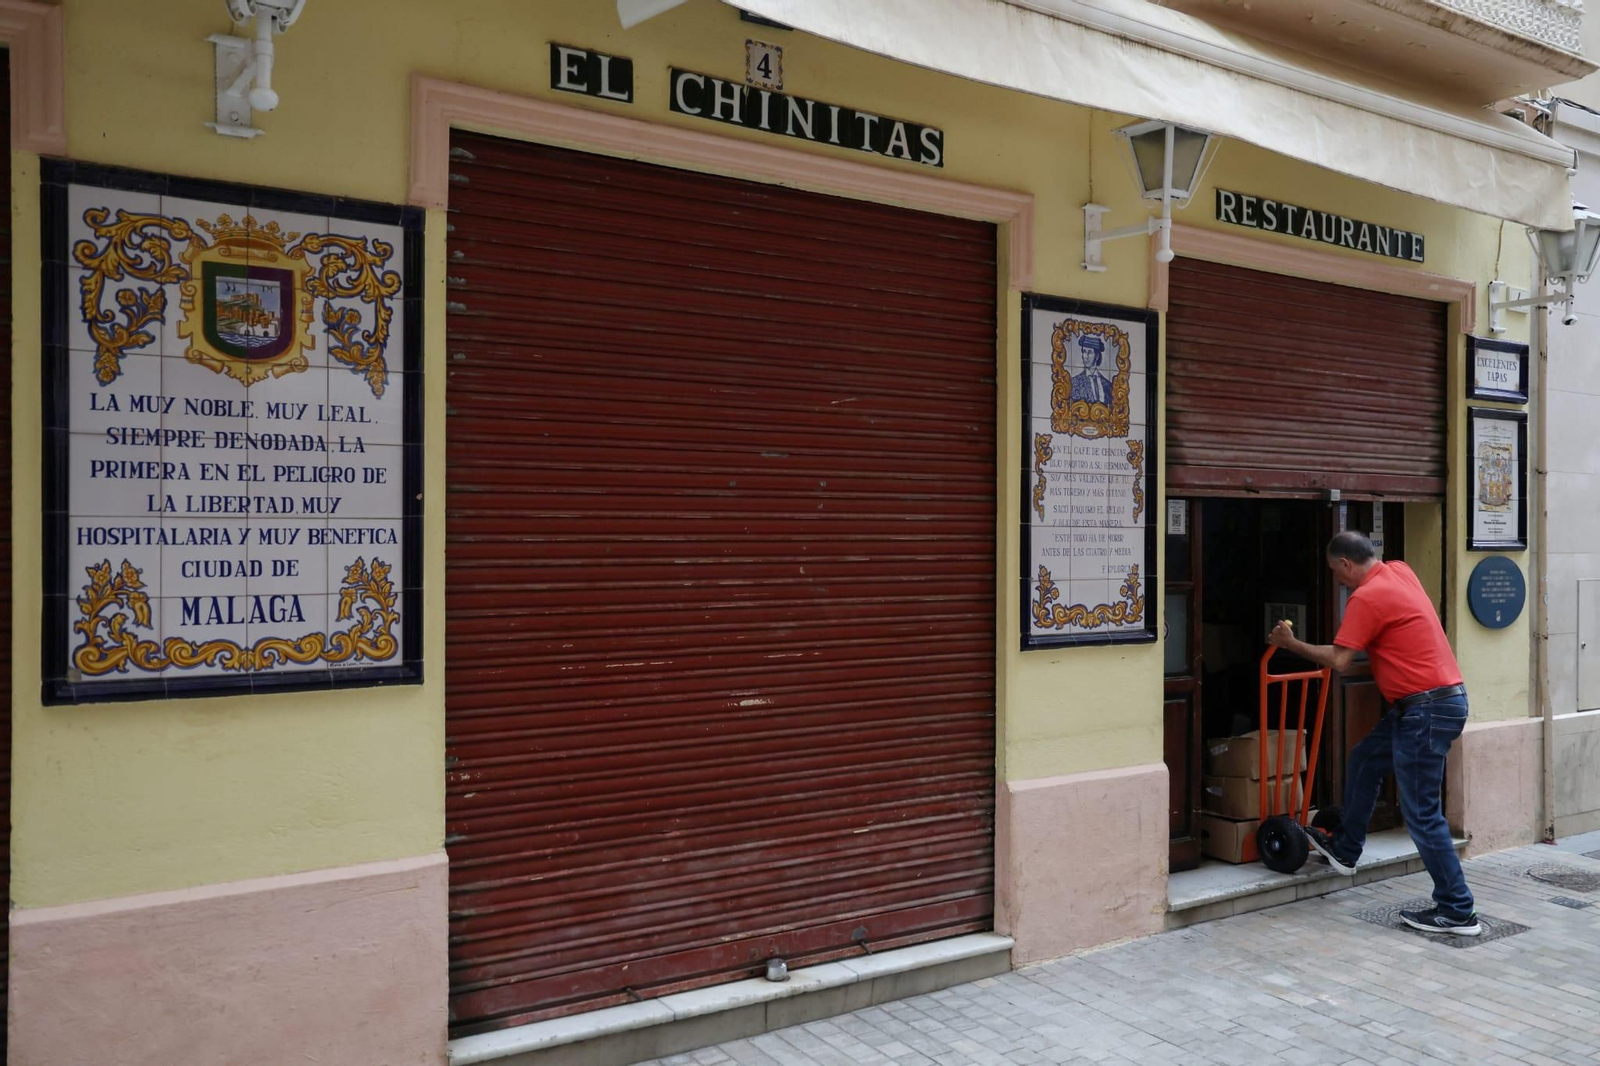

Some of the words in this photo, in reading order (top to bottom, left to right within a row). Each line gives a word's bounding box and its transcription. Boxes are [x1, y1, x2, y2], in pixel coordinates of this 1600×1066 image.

[757, 52, 773, 80] 4
[556, 46, 629, 101] EL
[675, 71, 942, 166] CHINITAS
[1218, 189, 1424, 262] RESTAURANTE
[1476, 356, 1517, 371] EXCELENTES
[1487, 371, 1507, 383] TAPAS
[89, 393, 121, 412] LA
[129, 394, 176, 413] MUY
[266, 402, 309, 421] MUY
[106, 427, 205, 448] SIEMPRE
[339, 435, 366, 453] LA
[1092, 447, 1099, 456] DE
[90, 460, 191, 480] PRIMERA
[200, 463, 230, 482] EN
[237, 464, 266, 482] EL
[273, 465, 356, 484] PELIGRO
[363, 467, 387, 484] DE
[147, 494, 177, 513] LA
[301, 497, 342, 514] MUY
[77, 527, 233, 546] HOSPITALARIA
[238, 527, 252, 546] Y
[258, 528, 301, 546] MUY
[307, 528, 398, 545] BENEFICA
[181, 560, 263, 578] CIUDAD
[271, 559, 299, 578] DE
[180, 595, 306, 626] MALAGA
